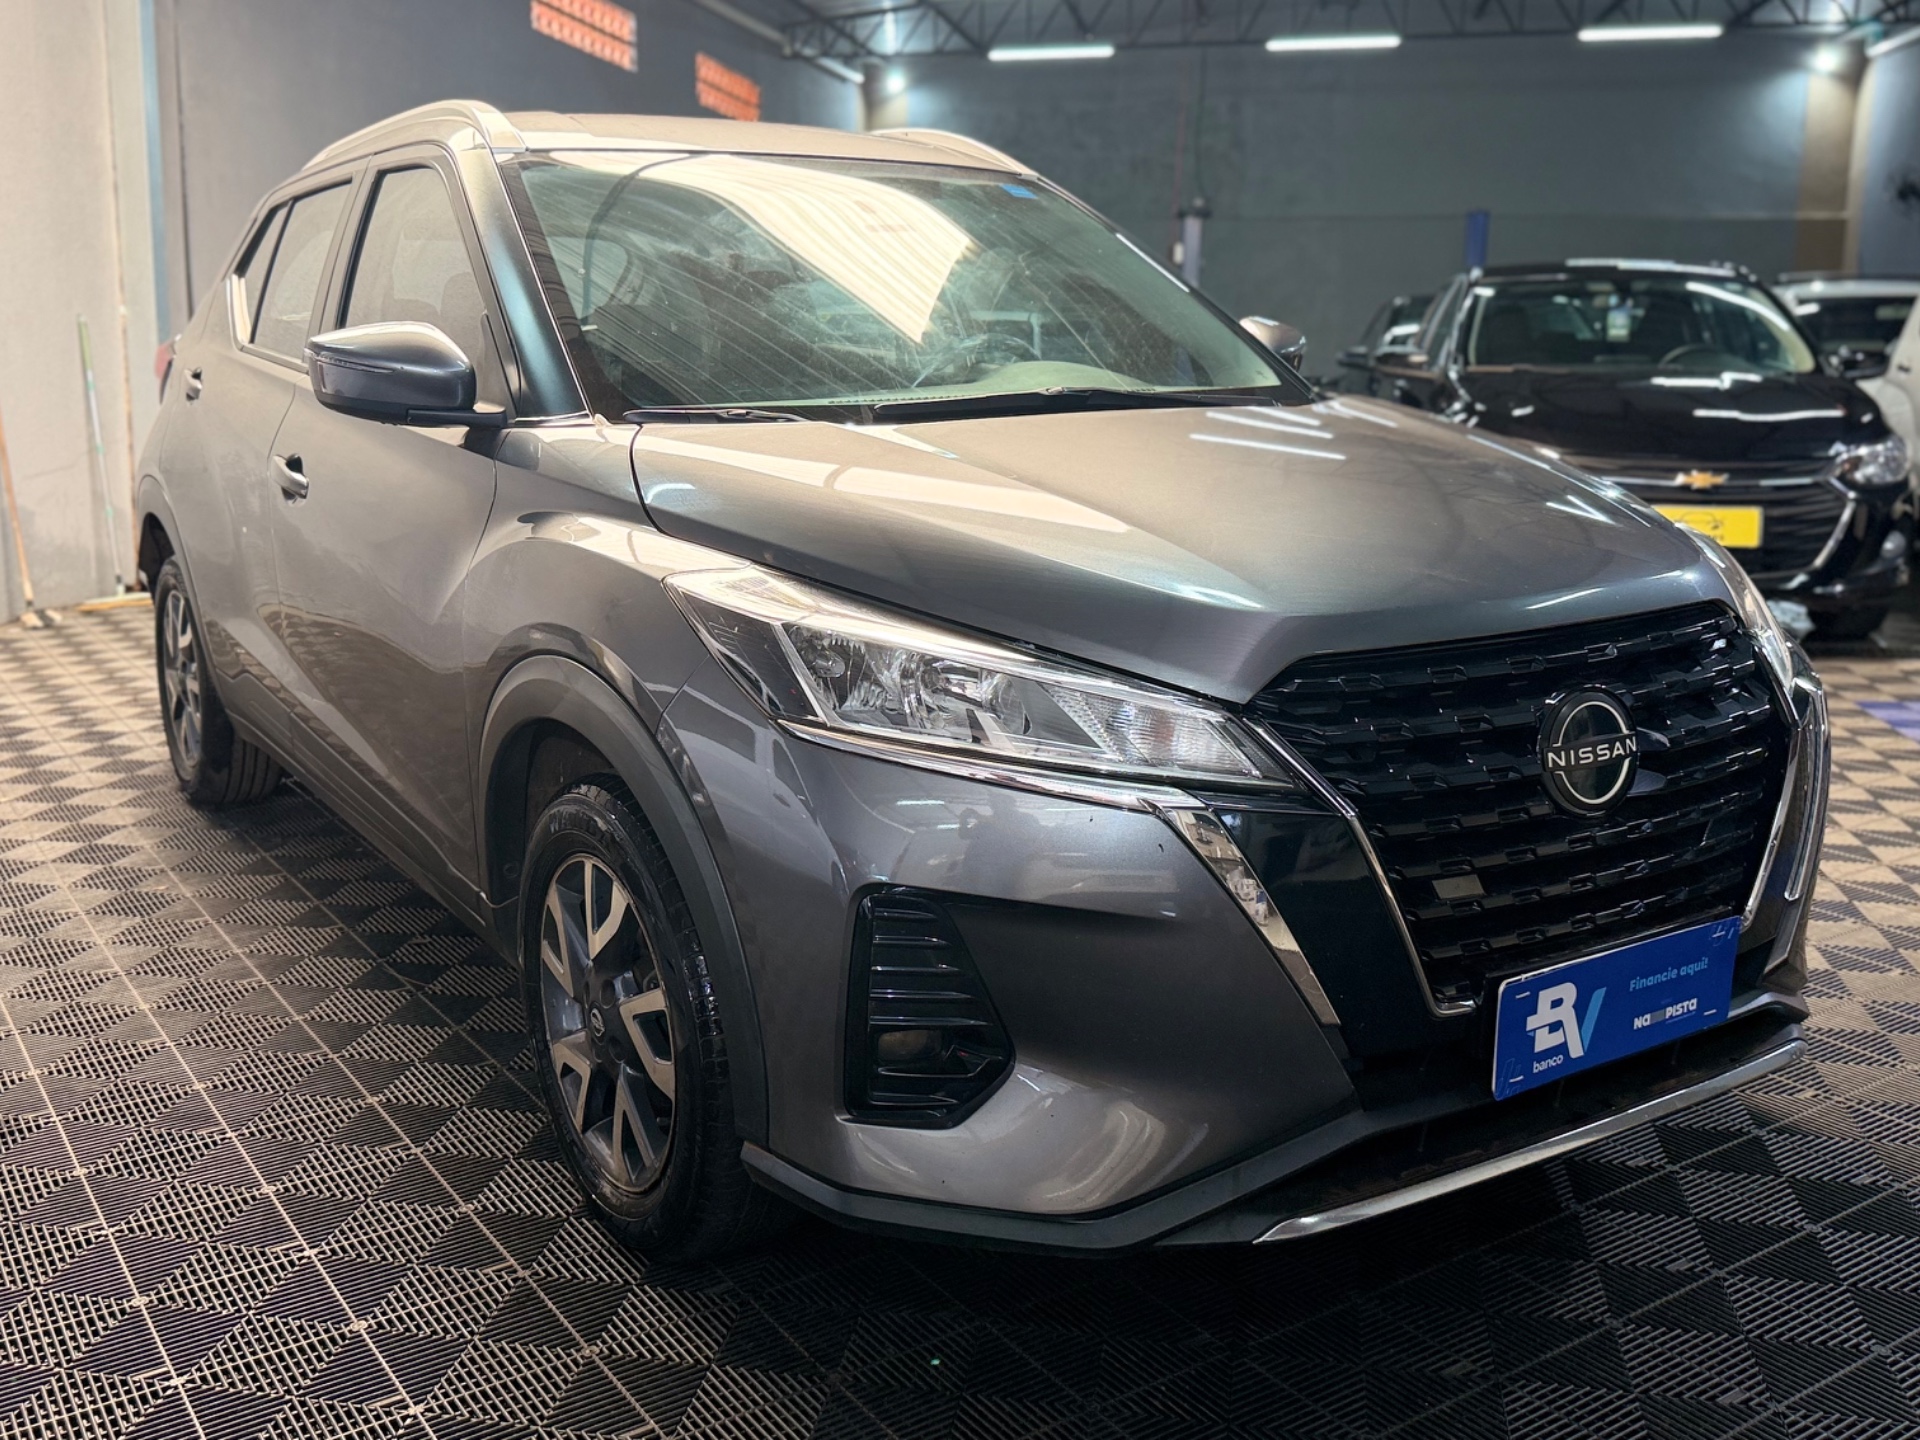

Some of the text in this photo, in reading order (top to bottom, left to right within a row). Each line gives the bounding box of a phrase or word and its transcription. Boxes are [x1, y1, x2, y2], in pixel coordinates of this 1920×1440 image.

[1547, 736, 1637, 768] NISSAN
[1629, 957, 1709, 992] Financie aqui!
[1532, 1054, 1564, 1074] banco
